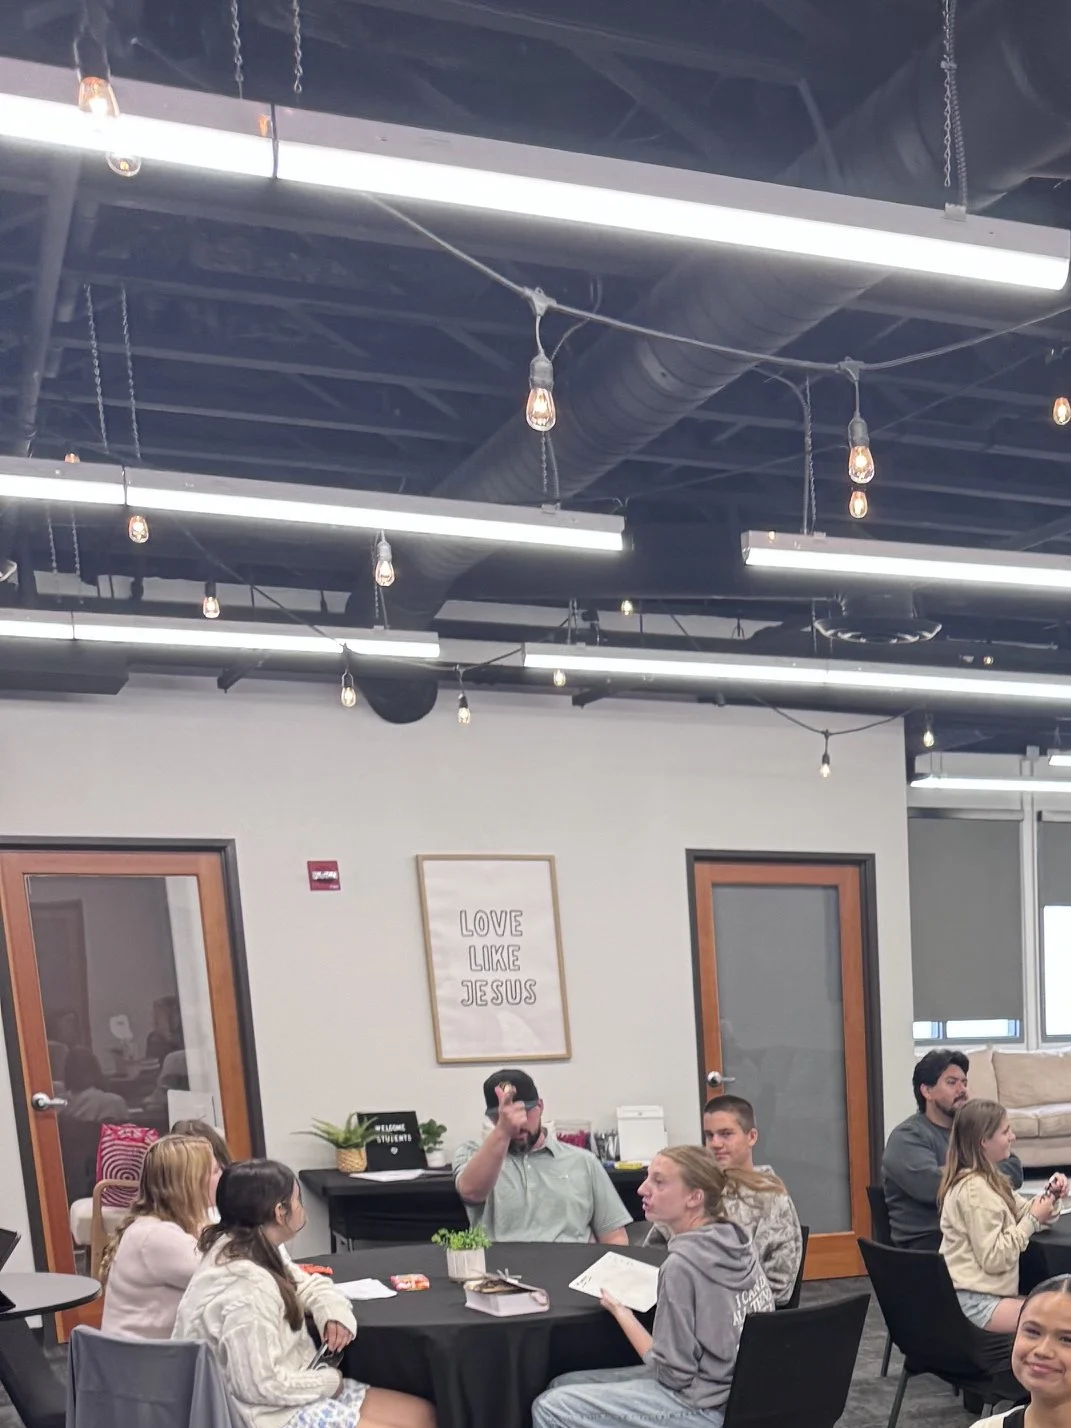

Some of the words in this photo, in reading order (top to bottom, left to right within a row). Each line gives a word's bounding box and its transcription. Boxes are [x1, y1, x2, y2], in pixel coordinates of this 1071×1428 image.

[459, 909, 523, 937] LOVE
[468, 944, 521, 972] LIKE
[460, 978, 537, 1007] JESUS
